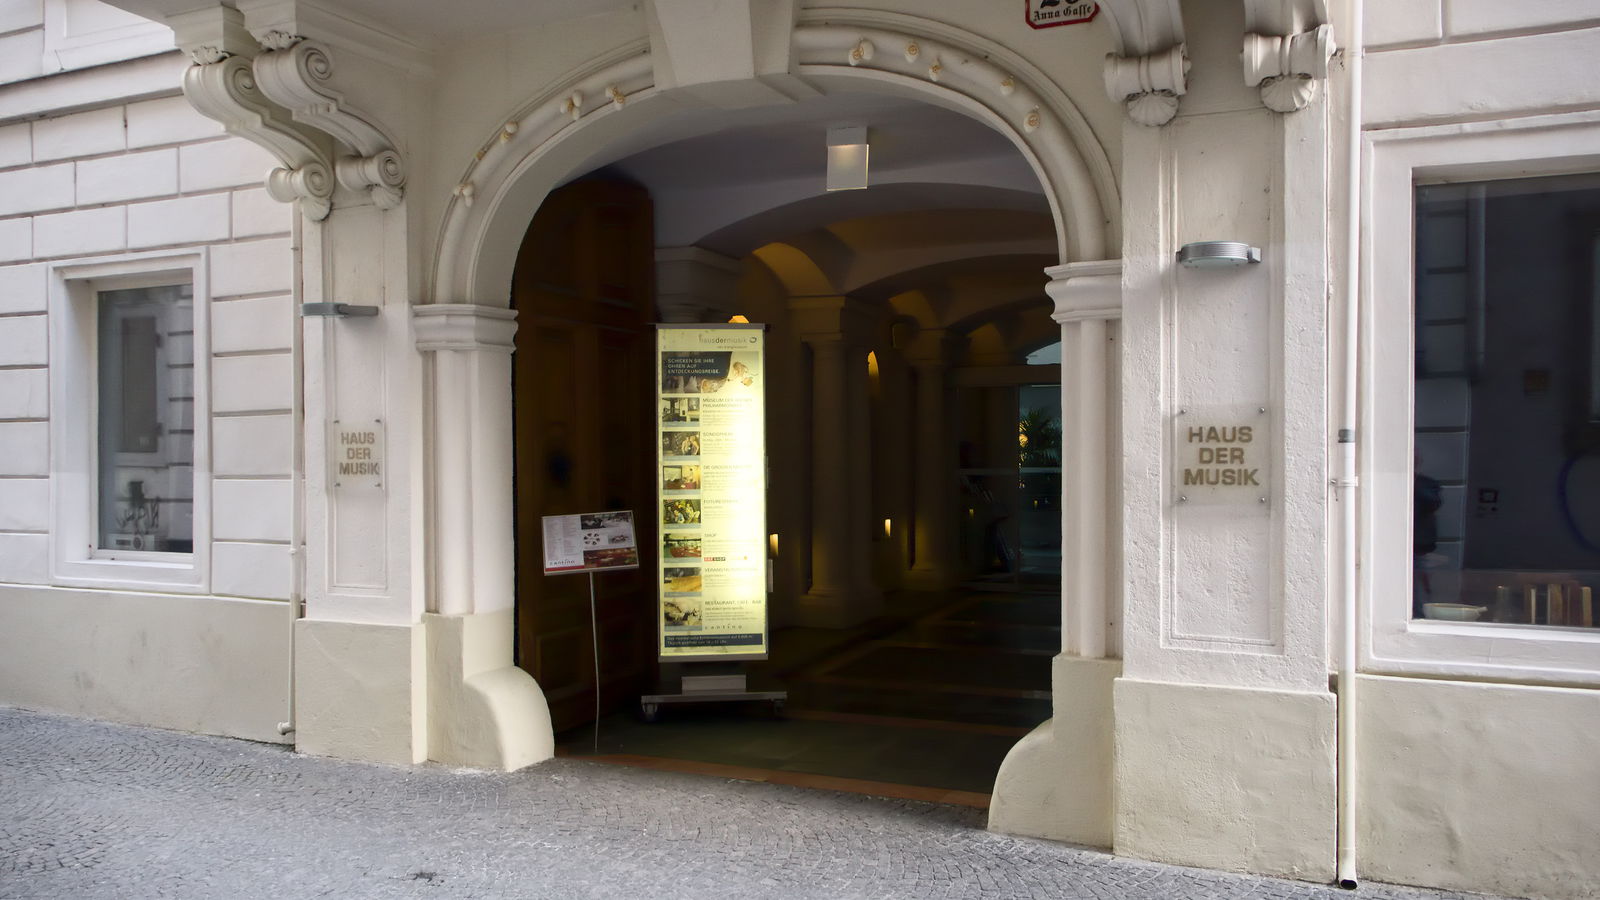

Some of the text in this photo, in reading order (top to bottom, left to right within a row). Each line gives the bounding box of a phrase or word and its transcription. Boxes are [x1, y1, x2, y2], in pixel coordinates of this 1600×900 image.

[1034, 10, 1060, 21] Anna
[341, 432, 375, 445] HAUS
[1188, 426, 1253, 443] HAUS
[347, 448, 371, 460] DER
[1198, 447, 1245, 465] DER
[339, 462, 380, 475] MUSIK
[1184, 468, 1260, 486] MUSIK
